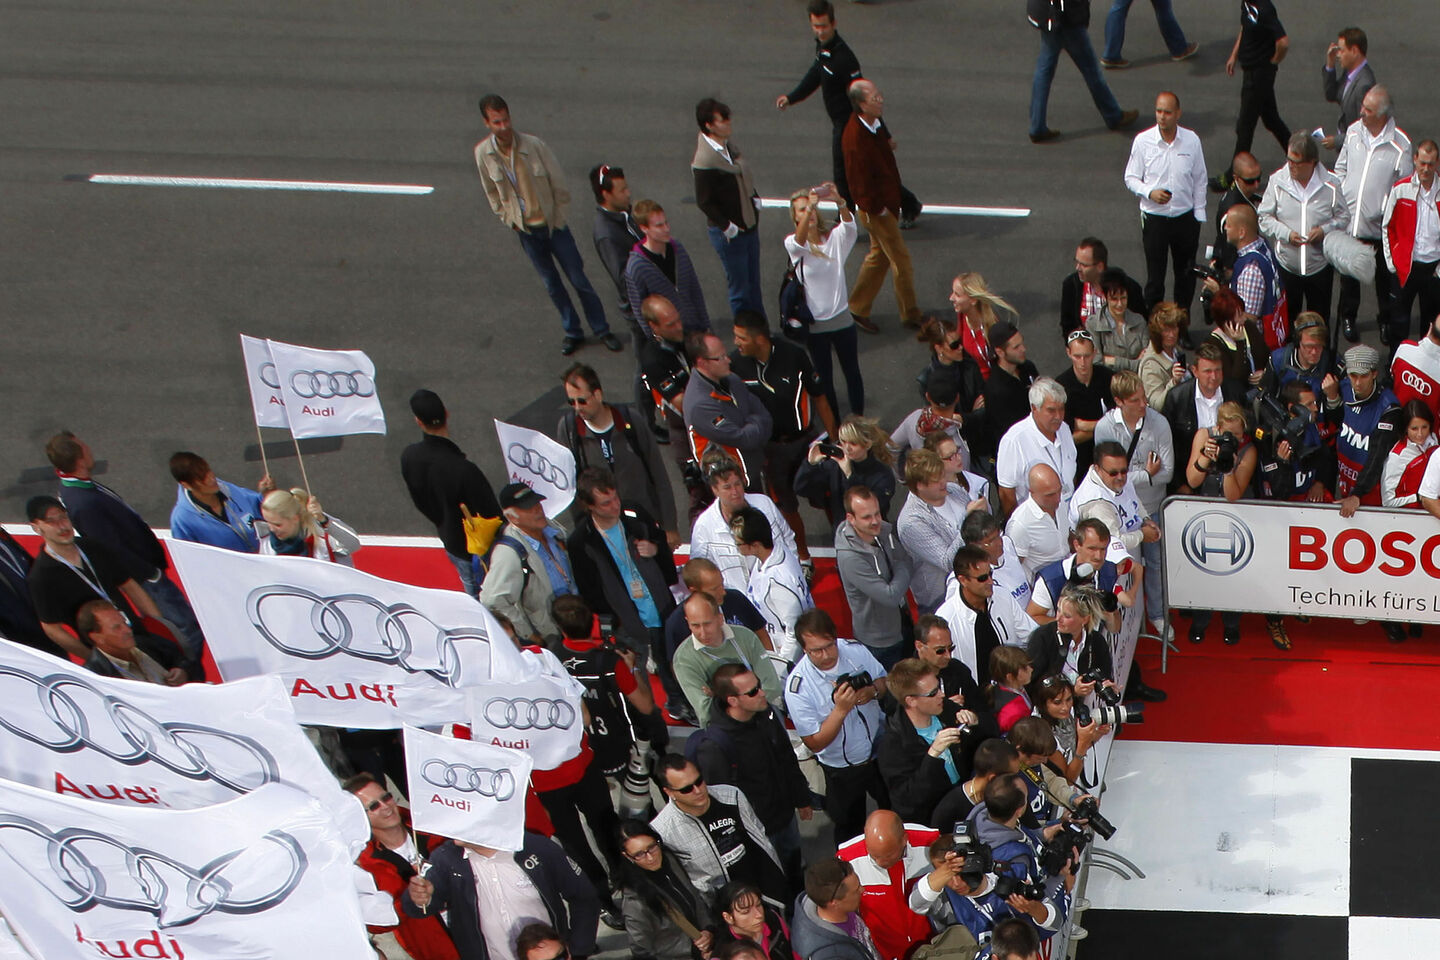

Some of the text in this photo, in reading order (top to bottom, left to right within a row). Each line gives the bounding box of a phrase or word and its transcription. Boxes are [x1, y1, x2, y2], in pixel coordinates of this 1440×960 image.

[302, 404, 335, 418] Audi
[1288, 585, 1377, 612] Technik
[1382, 591, 1427, 614] fürs
[291, 677, 396, 709] Audi
[491, 736, 530, 749] Audi
[54, 771, 166, 807] Audi
[431, 794, 471, 812] Audi
